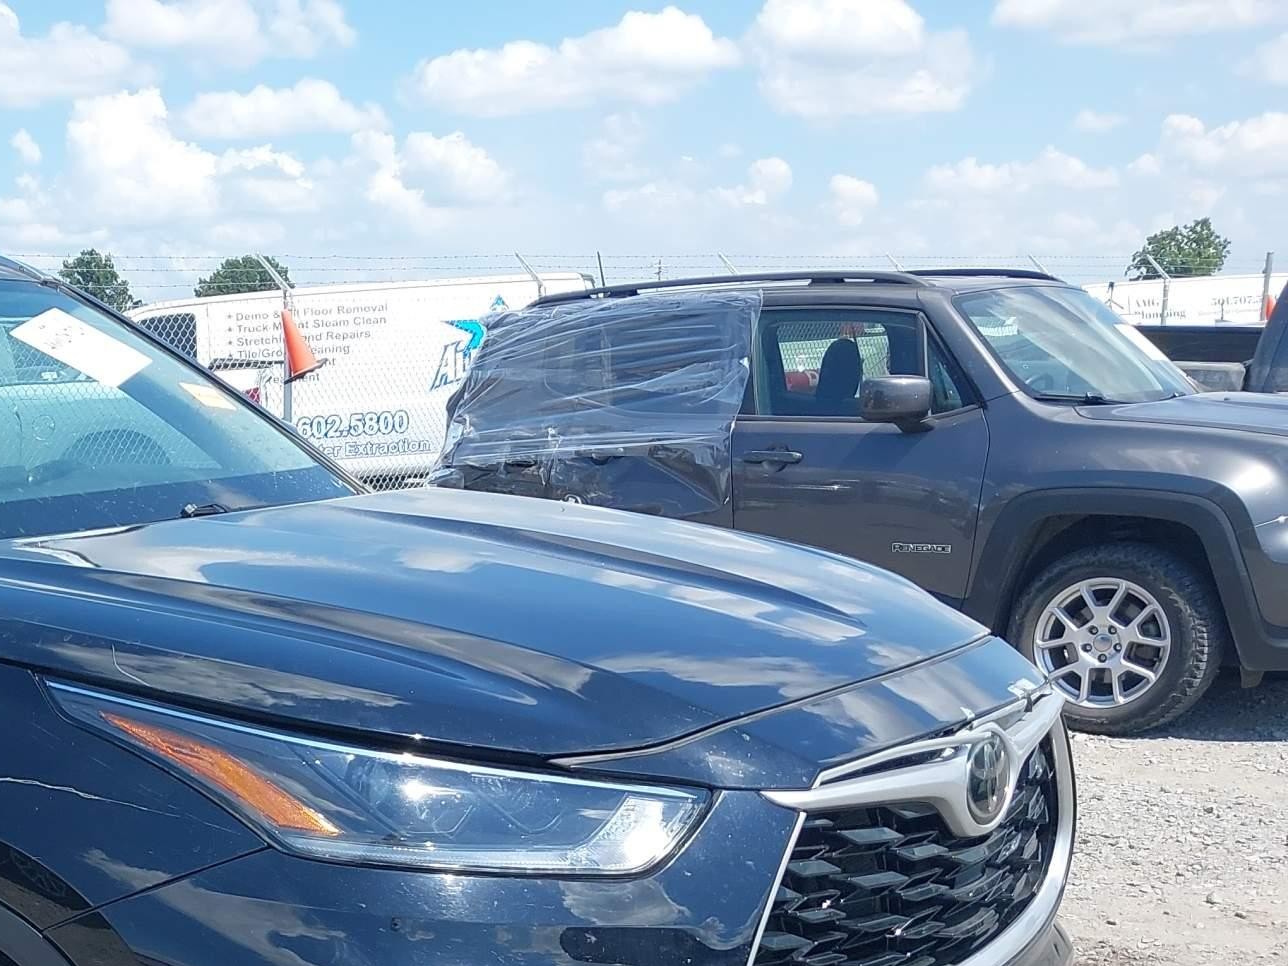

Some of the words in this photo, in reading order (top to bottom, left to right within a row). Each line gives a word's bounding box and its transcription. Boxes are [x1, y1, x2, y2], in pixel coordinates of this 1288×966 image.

[236, 311, 269, 321] Demo
[303, 307, 333, 317] Floor
[337, 303, 388, 315] Removal
[237, 323, 269, 333] Truck
[273, 320, 309, 331] Mnt
[313, 318, 349, 328] Steam
[353, 315, 387, 326] Clean
[236, 335, 283, 347] Stretchi
[326, 330, 371, 342] Repairs
[344, 438, 431, 456] Extraction
[892, 542, 951, 553] RENEGADE
